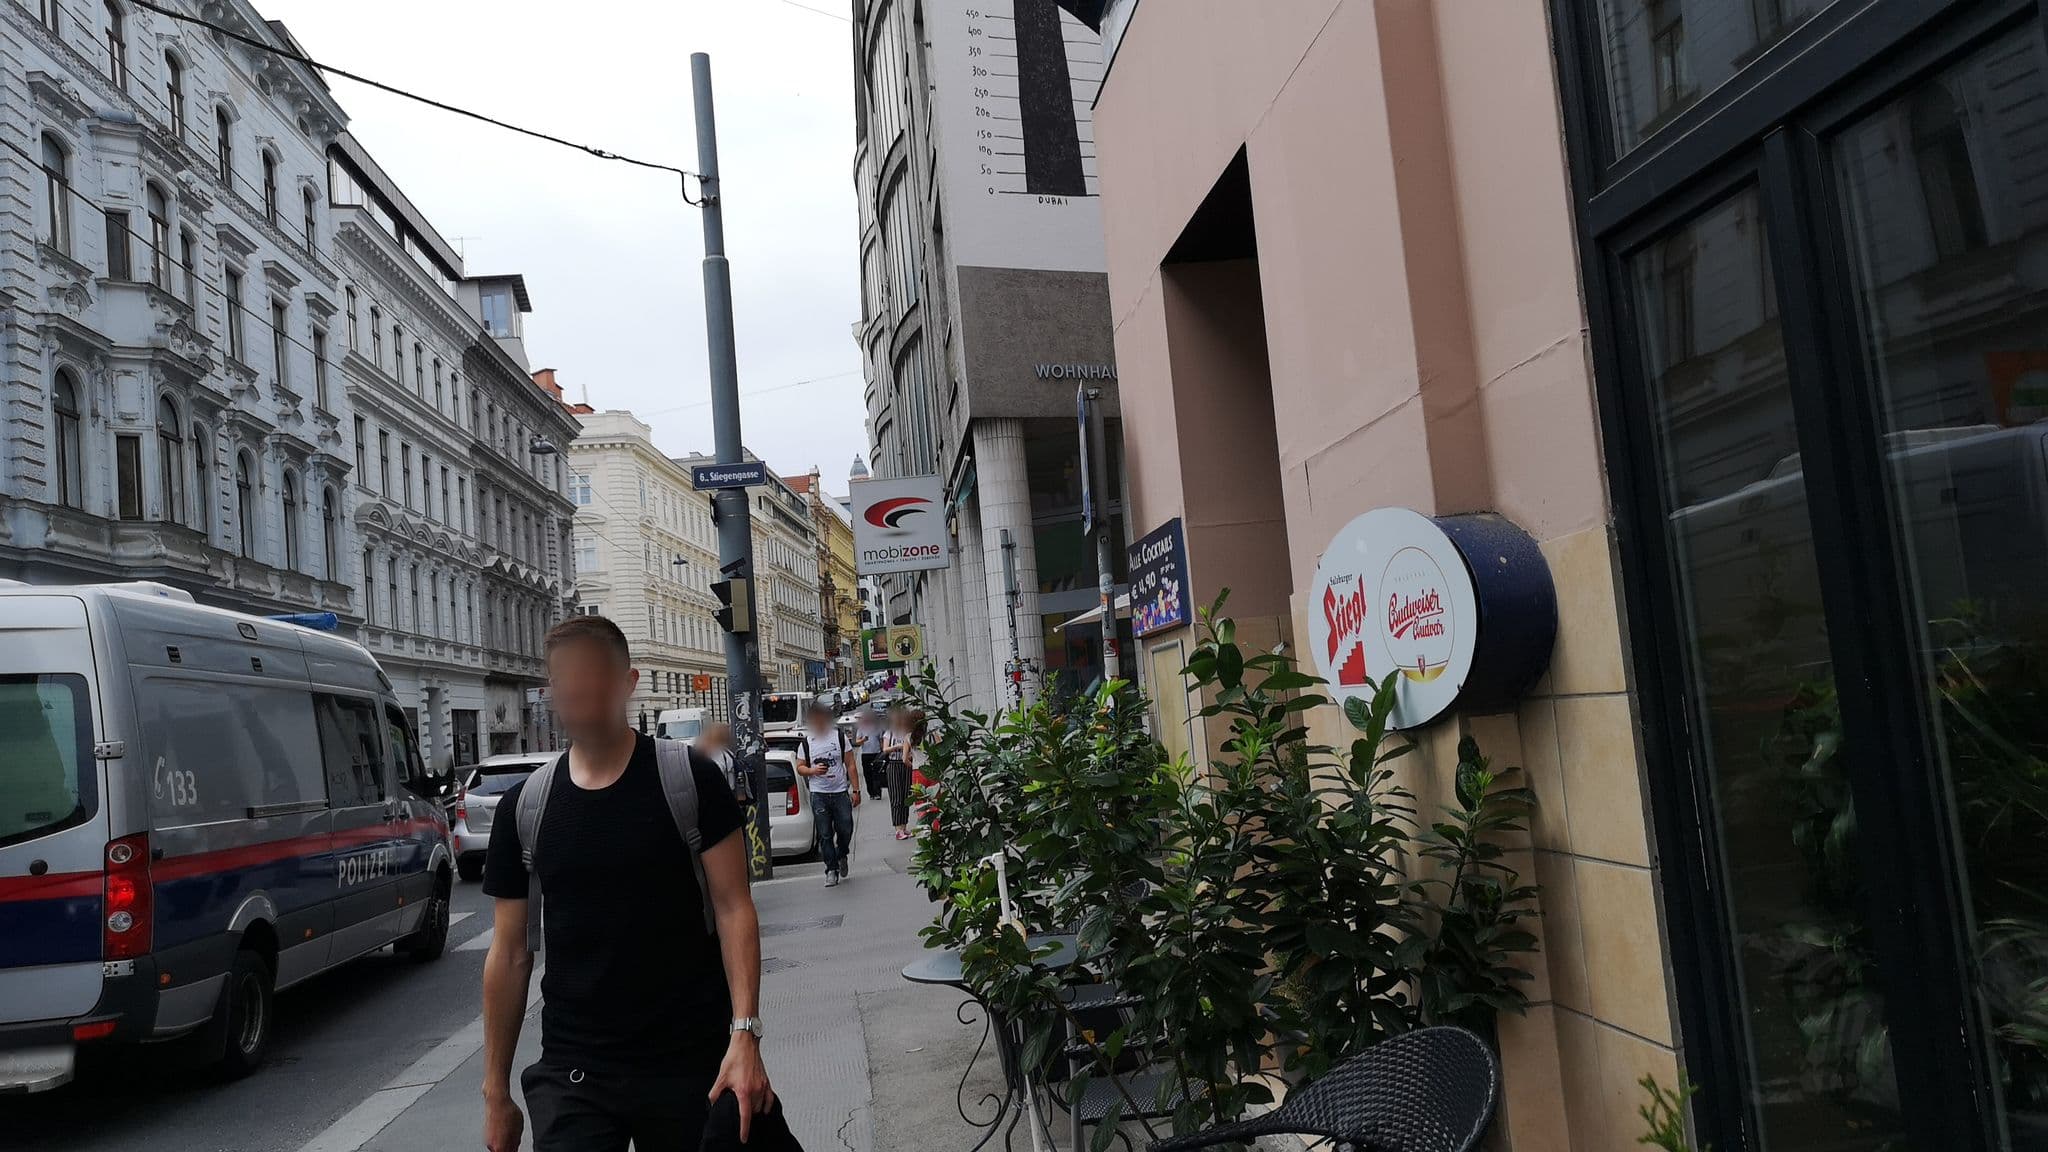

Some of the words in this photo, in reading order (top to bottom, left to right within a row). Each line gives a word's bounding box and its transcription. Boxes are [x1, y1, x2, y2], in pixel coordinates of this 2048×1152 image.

[966, 10, 980, 18] 450
[968, 26, 982, 37] 400
[968, 47, 982, 57] 350
[972, 65, 987, 76] 300
[974, 87, 989, 98] 250
[975, 106, 990, 117] 200
[977, 129, 992, 139] 150
[979, 145, 992, 156] 100
[981, 164, 992, 175] 50
[988, 187, 994, 195] 0
[1038, 196, 1068, 206] DUBAI
[709, 471, 759, 482] Stiegengasse
[864, 544, 940, 561] mobizone
[1138, 571, 1157, 595] 4,90
[1388, 588, 1444, 636] Budweiser
[1323, 574, 1367, 668] Stiegl
[167, 770, 198, 806] 133
[338, 849, 389, 889] POLIZEI
